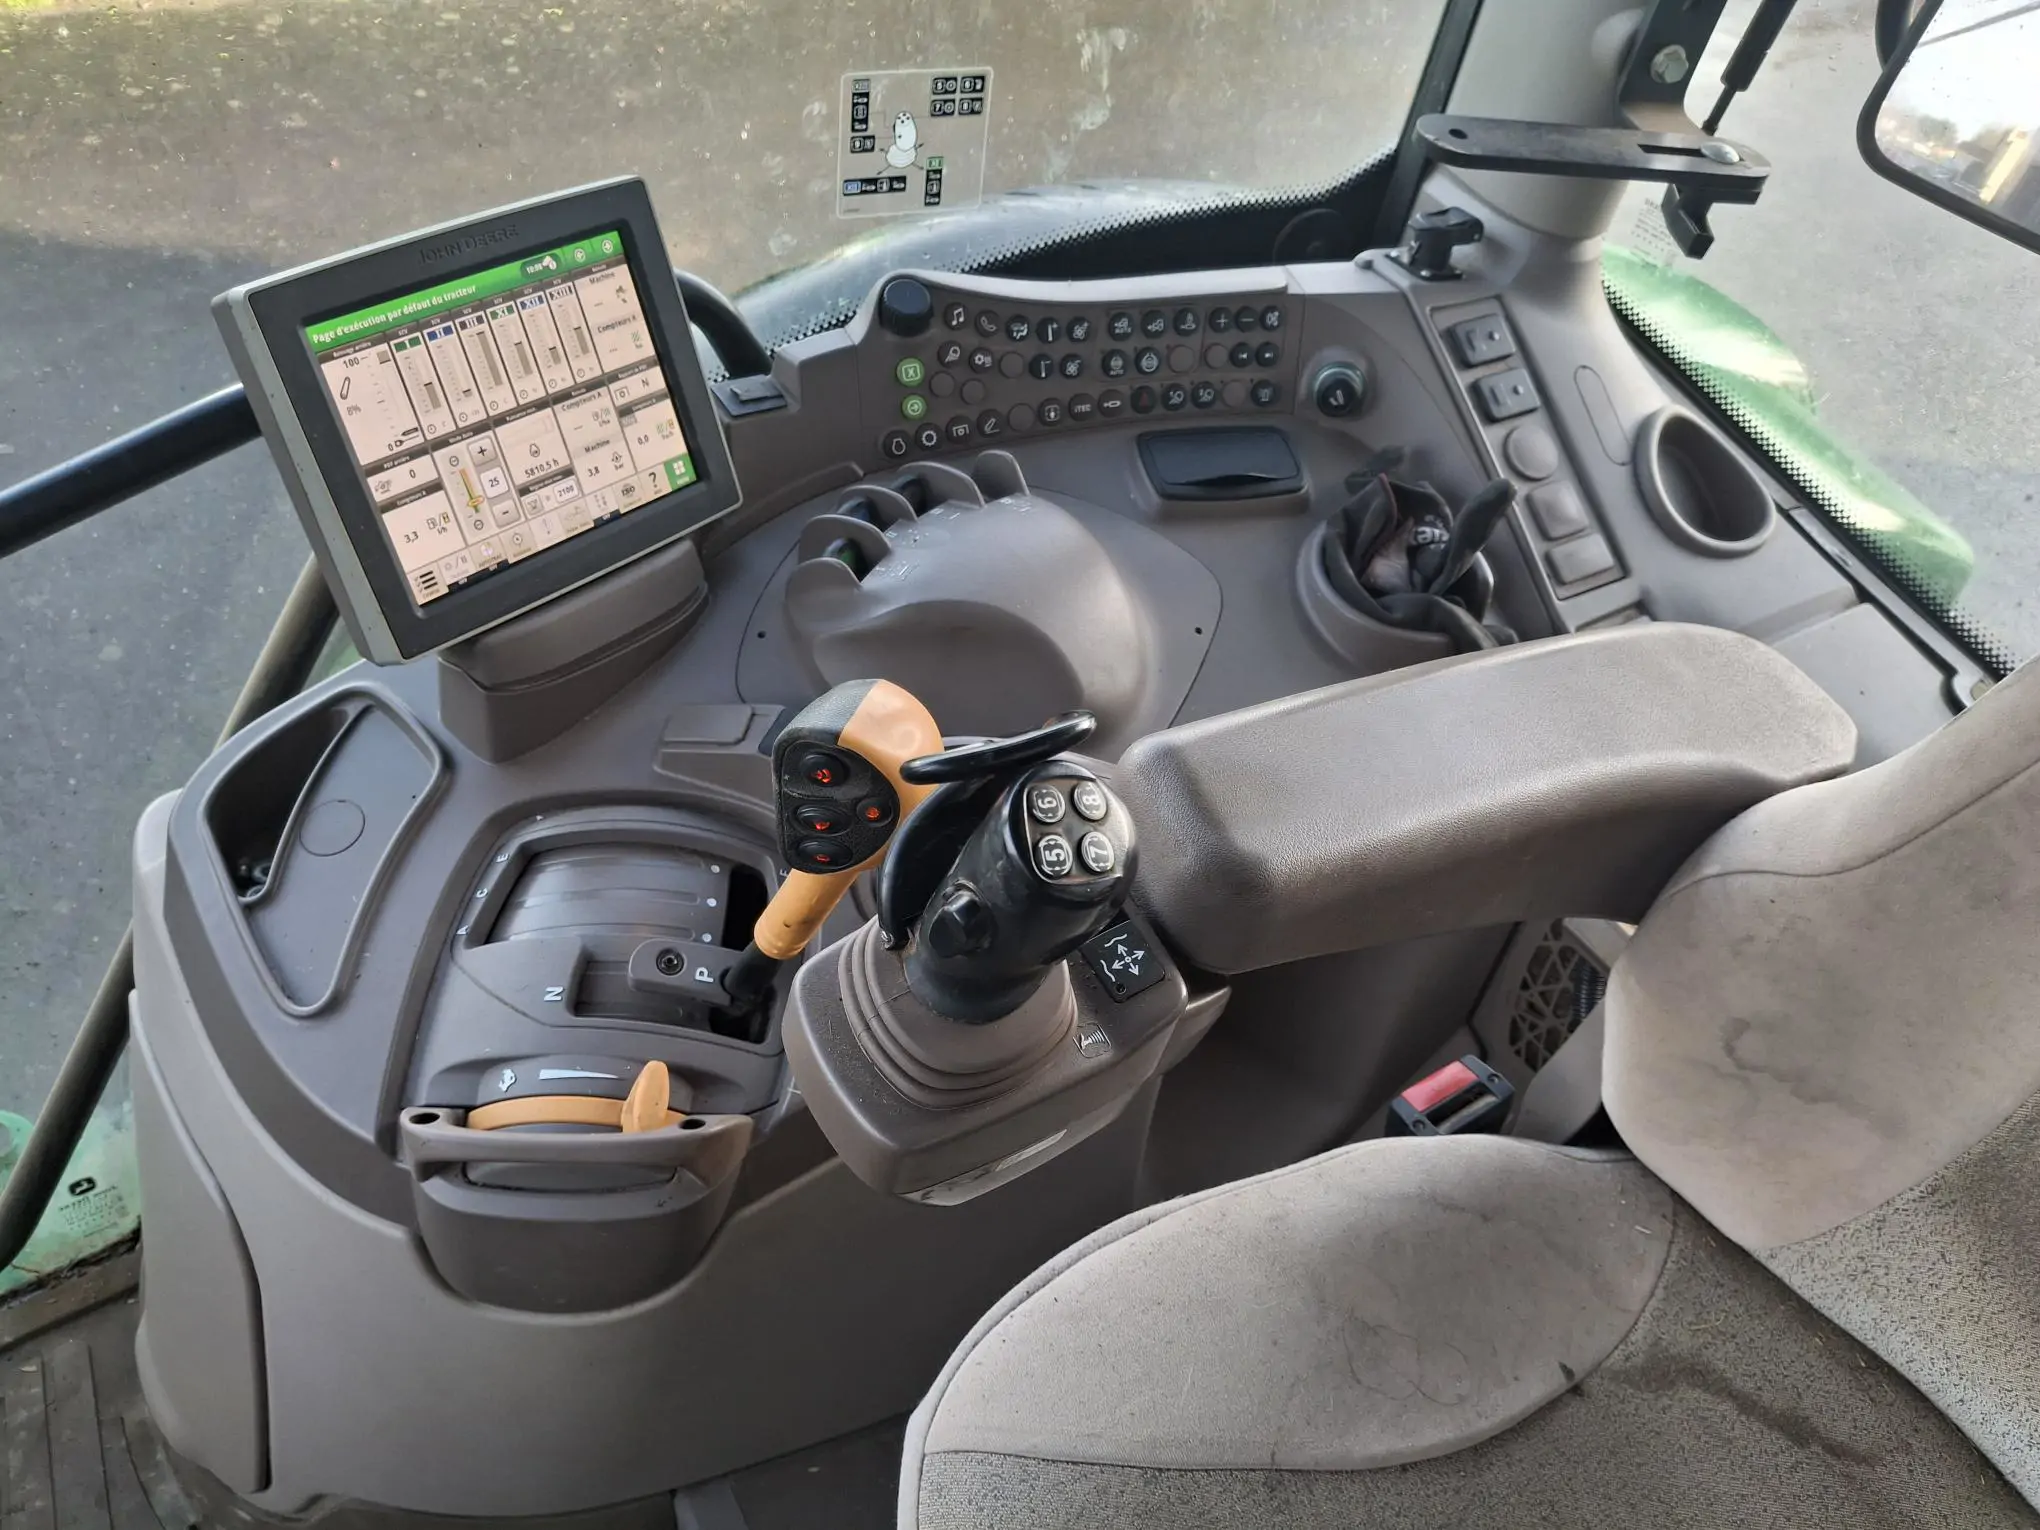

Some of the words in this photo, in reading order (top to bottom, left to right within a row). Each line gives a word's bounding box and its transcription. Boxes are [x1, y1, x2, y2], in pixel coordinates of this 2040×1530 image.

[550, 287, 569, 300] XIII
[523, 296, 540, 308] XII
[312, 331, 335, 343] Page
[336, 314, 386, 336] d'exécution
[387, 309, 401, 321] par
[403, 299, 431, 314] défaut
[432, 296, 442, 304] du
[443, 285, 476, 301] tracteur
[494, 307, 509, 318] XI
[343, 357, 359, 368] 100
[641, 379, 650, 387] N
[561, 394, 596, 411] Compteurs
[638, 434, 649, 445] 0,0
[584, 440, 610, 453] Machine
[409, 469, 416, 478] 0
[525, 461, 552, 478] 5810,5
[588, 466, 600, 477] 3,8
[489, 477, 499, 487] 25
[404, 531, 419, 543] 3,3
[1037, 797, 1057, 809] 6
[1082, 795, 1101, 805] 8
[496, 853, 509, 863] E
[1044, 848, 1065, 861] 5
[1089, 846, 1108, 858] 7
[476, 887, 488, 898] C
[456, 925, 469, 935] A
[694, 966, 714, 983] P
[543, 985, 564, 1002] N
